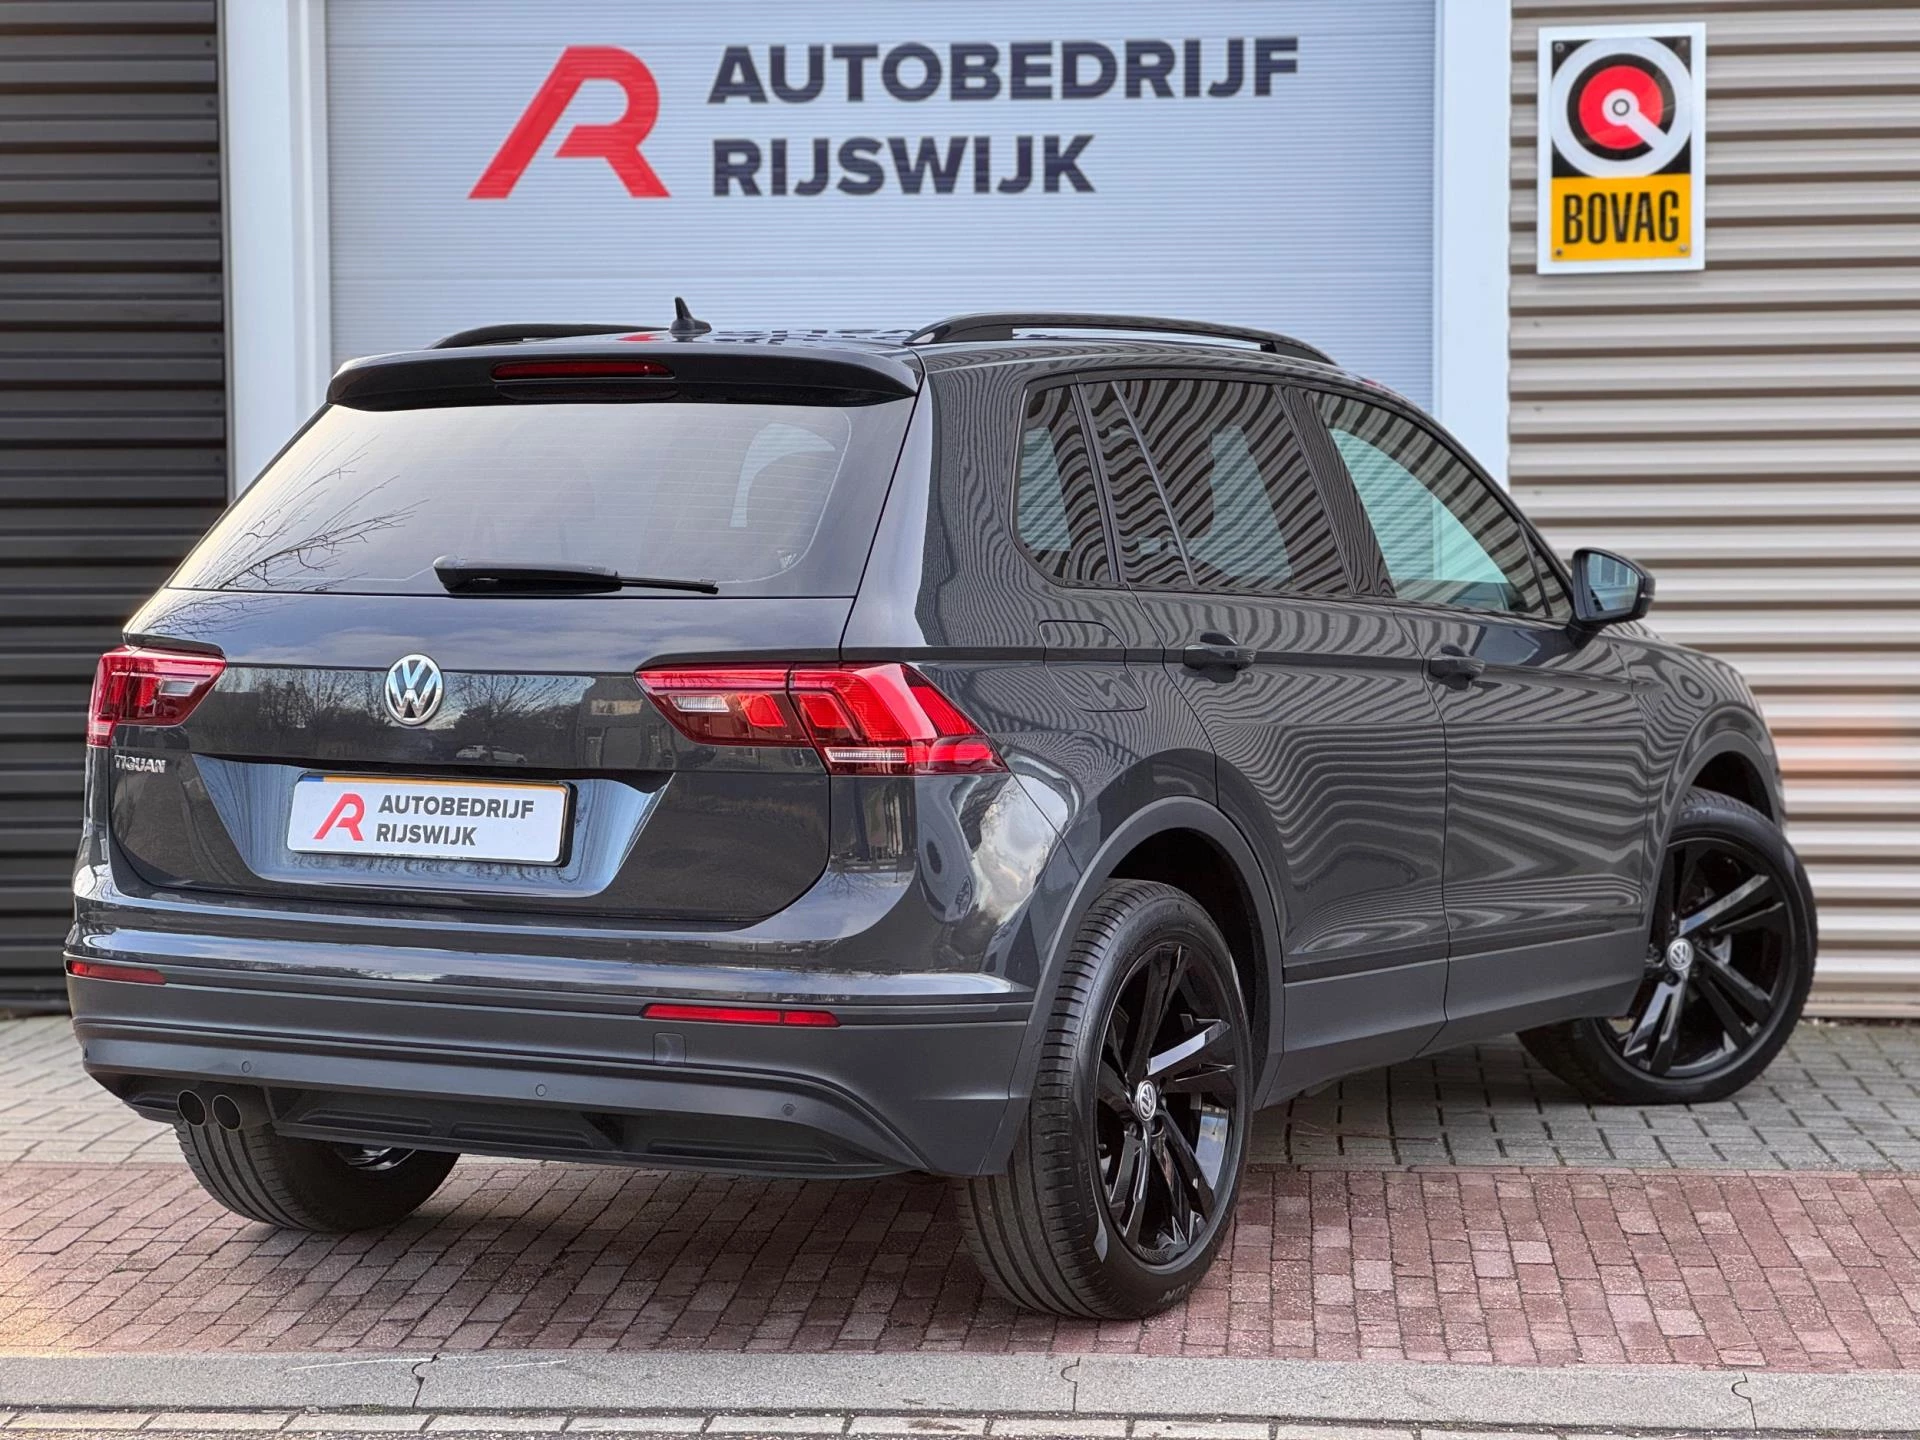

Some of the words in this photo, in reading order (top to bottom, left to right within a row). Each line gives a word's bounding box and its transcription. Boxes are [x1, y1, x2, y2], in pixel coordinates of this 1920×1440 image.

[707, 37, 1299, 104] AUTOBEDRIJF
[711, 134, 1097, 197] RIJSWIJK
[1562, 190, 1680, 245] BOVAG
[385, 654, 443, 726] VW
[114, 754, 167, 774] TIGUAN
[377, 794, 535, 820] AUTOBEDRIJF
[376, 823, 477, 847] RIJSWIJK
